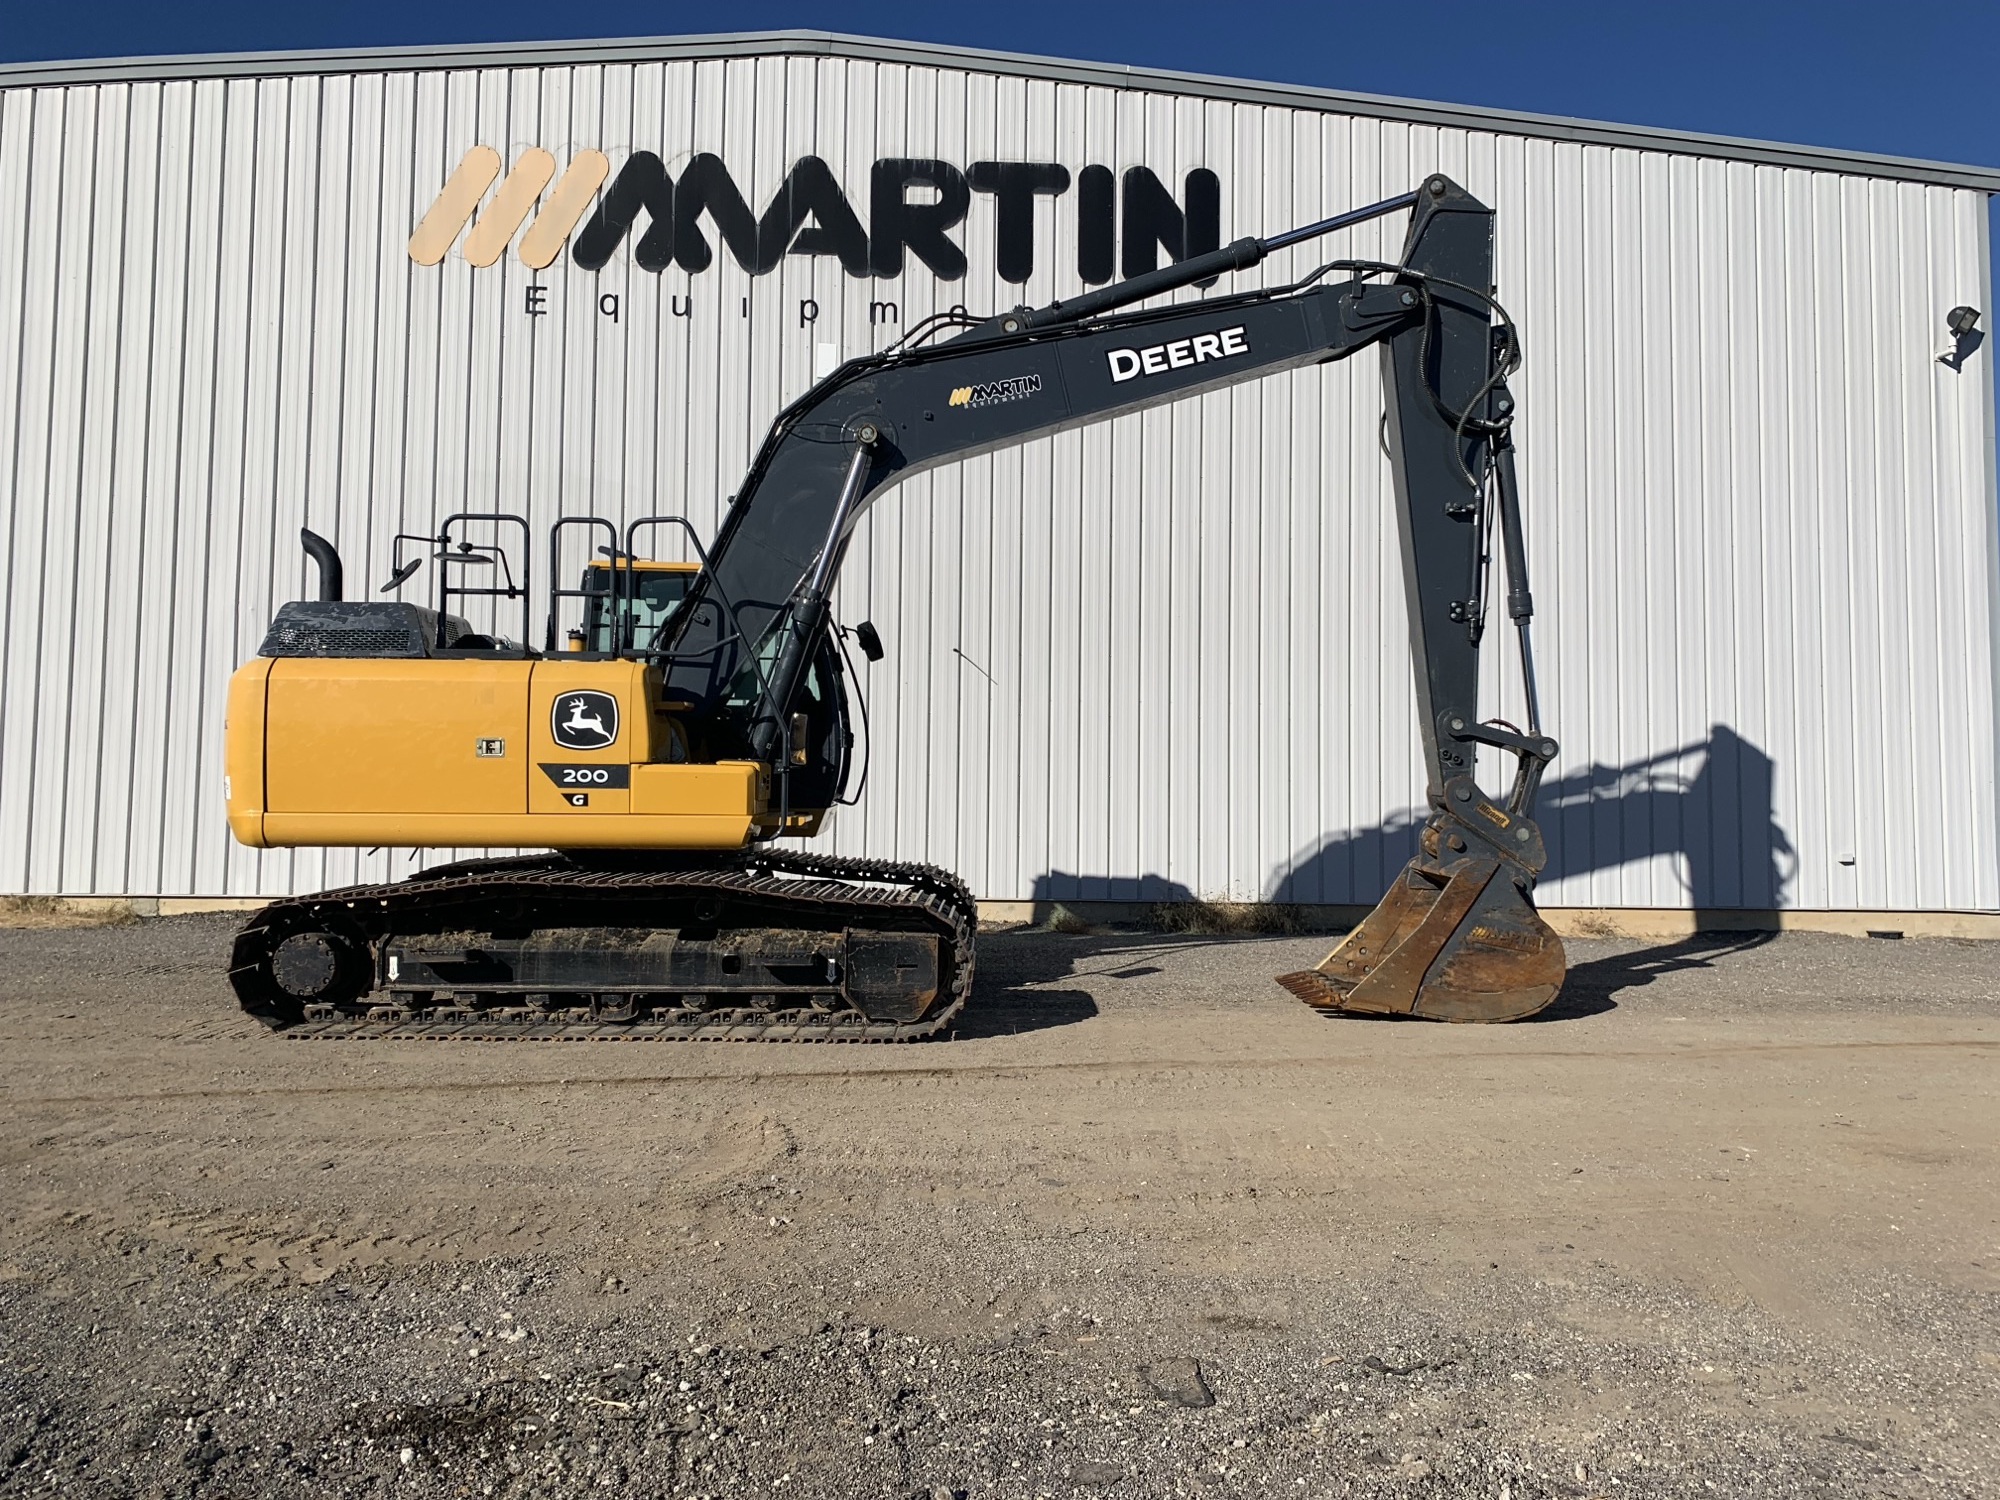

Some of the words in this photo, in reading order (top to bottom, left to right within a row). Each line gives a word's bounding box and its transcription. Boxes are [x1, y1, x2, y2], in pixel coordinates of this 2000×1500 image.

[572, 150, 1220, 288] MARTIN
[1107, 326, 1249, 383] DEERE
[969, 374, 1042, 403] MARTIN
[563, 769, 609, 784] 200
[572, 794, 585, 806] G
